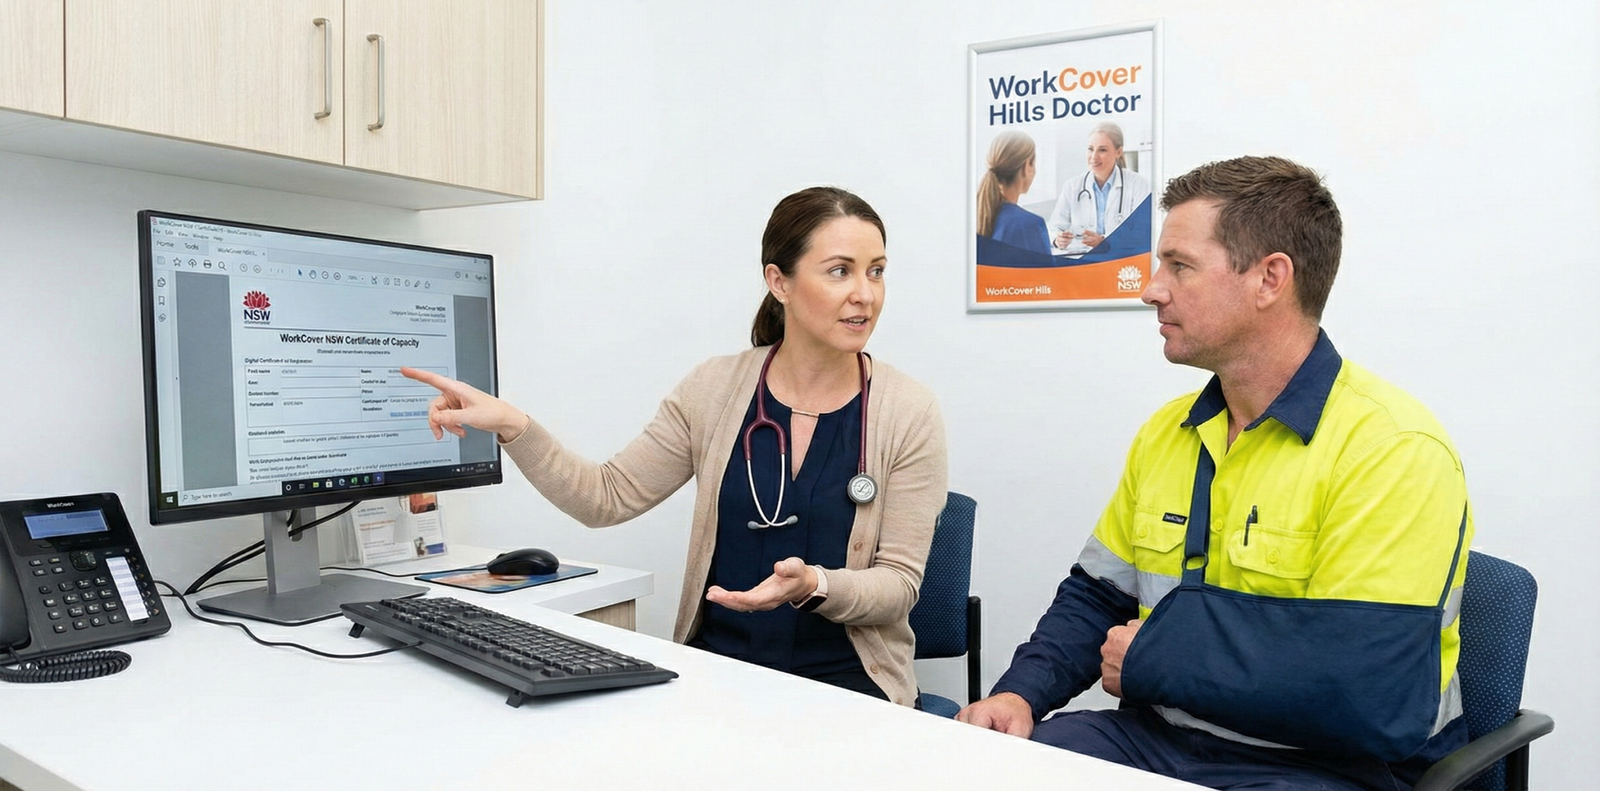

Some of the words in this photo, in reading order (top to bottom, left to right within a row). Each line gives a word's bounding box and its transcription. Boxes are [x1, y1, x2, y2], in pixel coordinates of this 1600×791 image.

[989, 65, 1142, 100] WorkCover
[989, 100, 1045, 126] Hills
[1052, 93, 1142, 120] Doctor
[156, 240, 174, 248] Home
[184, 242, 200, 251] Tools
[1117, 280, 1142, 290] NSW
[985, 287, 1033, 296] WorkCover
[1035, 286, 1052, 295] Hills
[244, 309, 270, 321] NSW
[280, 333, 324, 343] WorkCover
[325, 335, 344, 344] NSW
[345, 335, 381, 345] Certificate
[382, 337, 390, 346] of
[391, 338, 420, 348] Capacity
